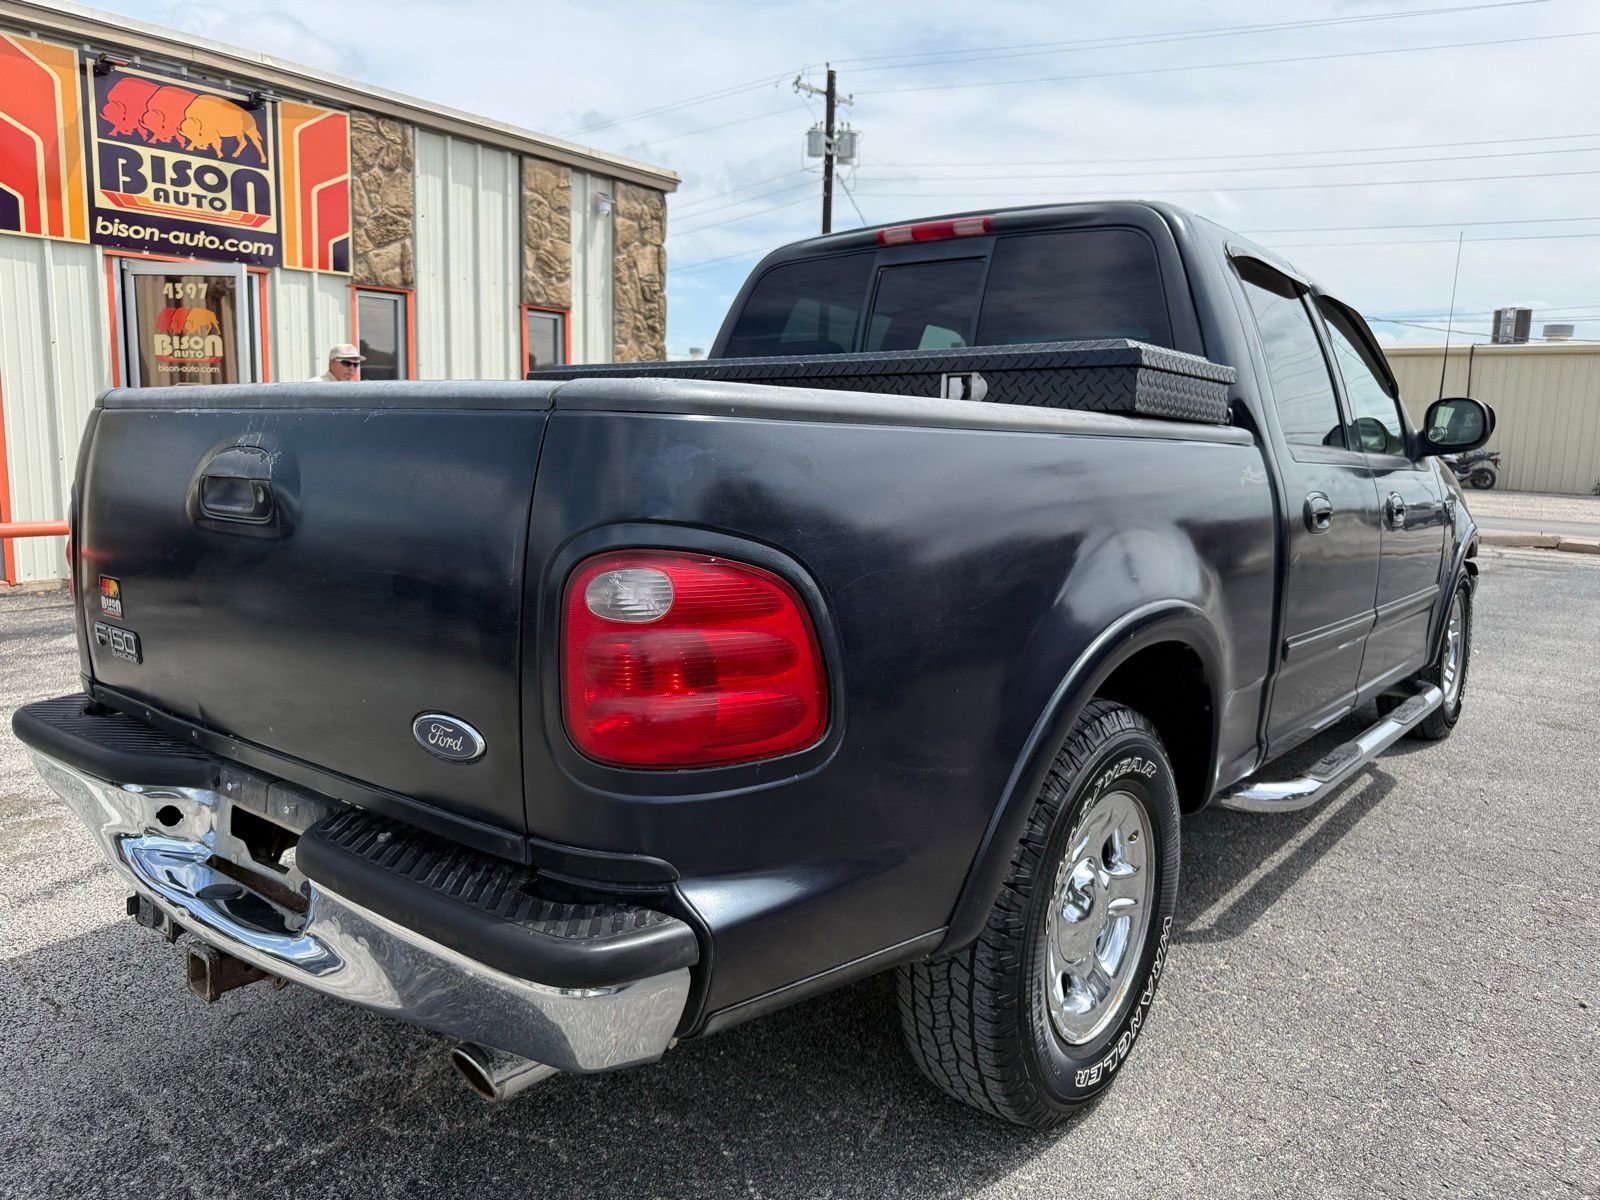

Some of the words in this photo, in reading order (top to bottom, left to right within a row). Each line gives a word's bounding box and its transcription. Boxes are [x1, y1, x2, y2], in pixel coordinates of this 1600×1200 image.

[98, 142, 271, 216] BISON
[153, 187, 227, 212] AUTO
[95, 216, 274, 257] bison-auto.com
[162, 283, 208, 300] 4397
[153, 334, 223, 357] BISON
[174, 350, 204, 358] AUTO
[158, 364, 220, 374] bison-auto.com
[428, 723, 463, 752] Ford
[1074, 915, 1173, 1088] WRANGLER
